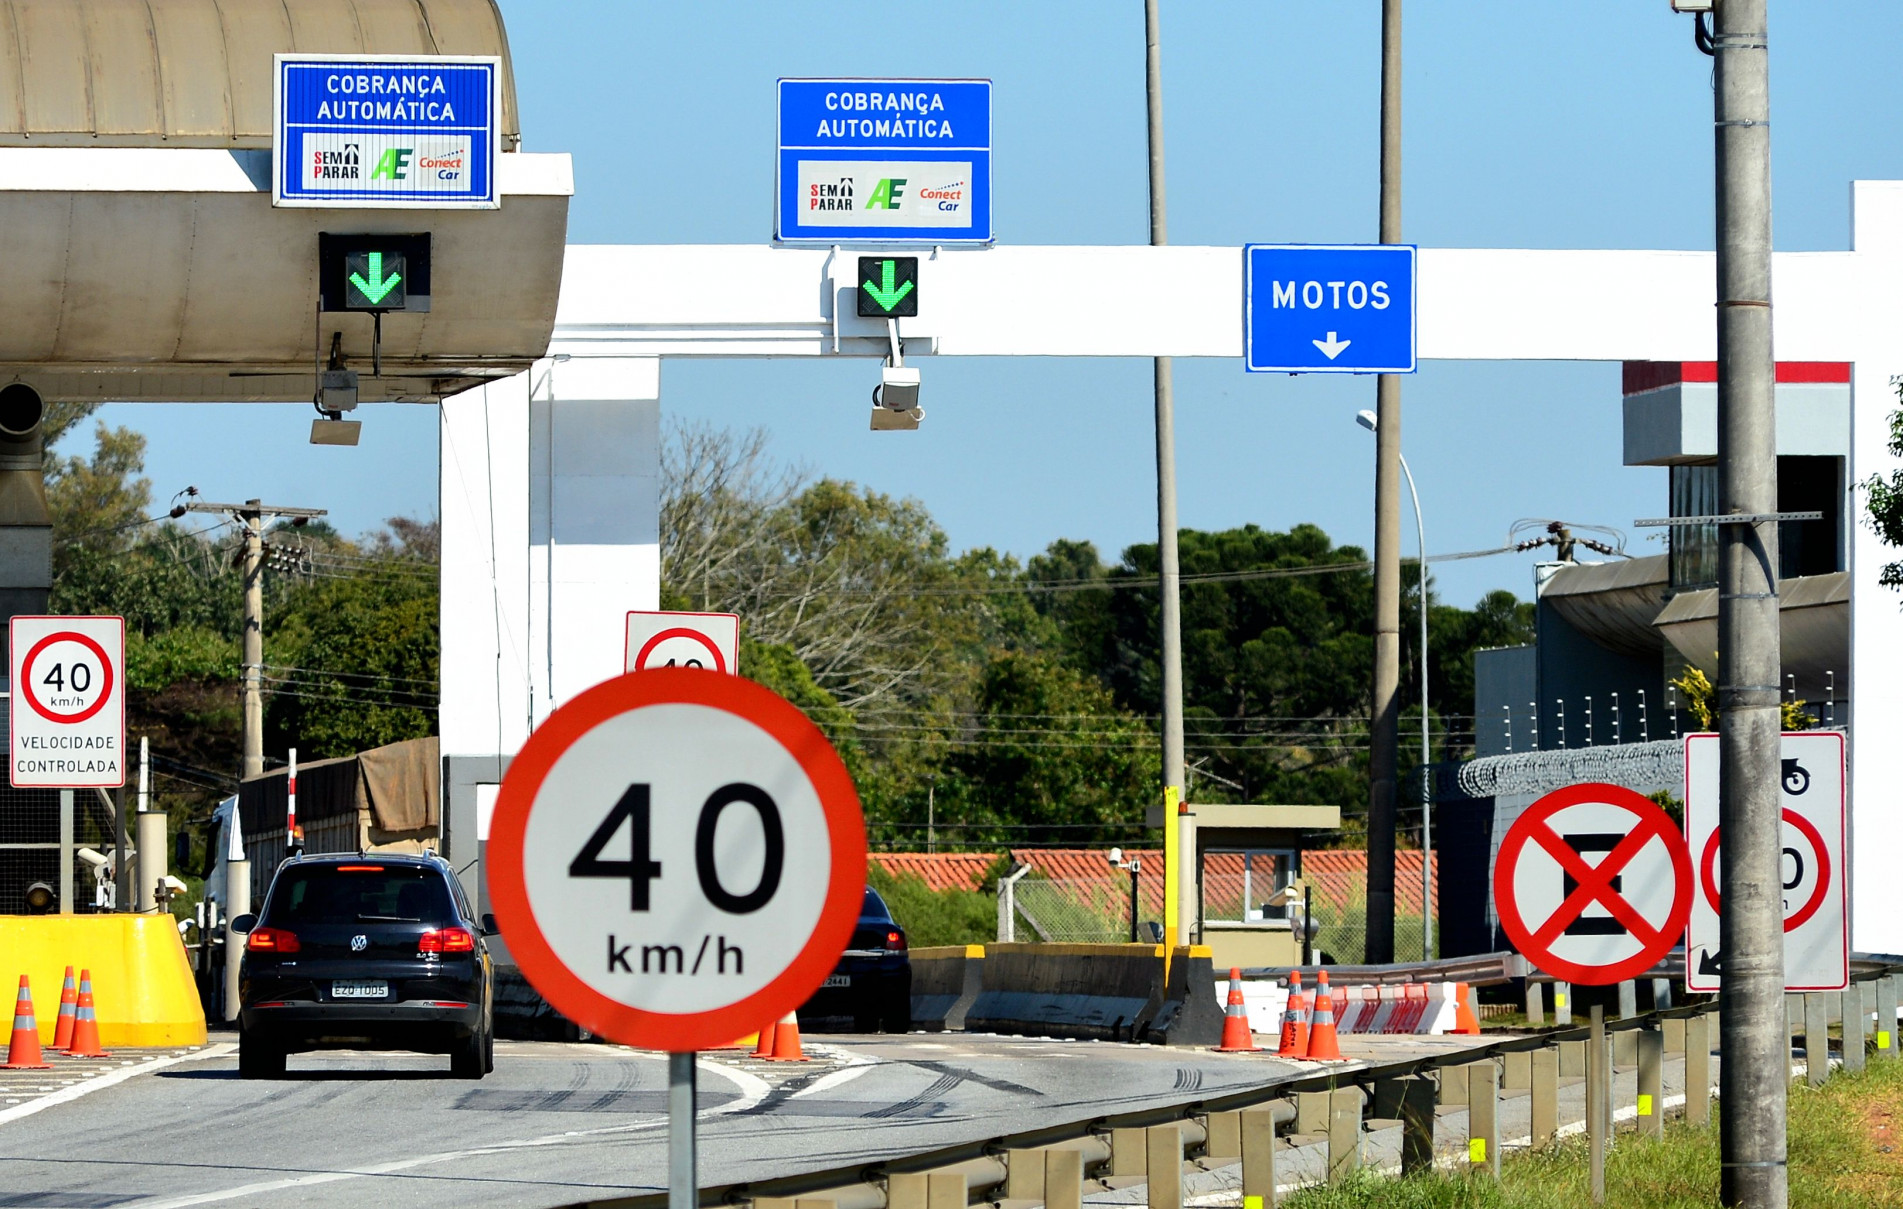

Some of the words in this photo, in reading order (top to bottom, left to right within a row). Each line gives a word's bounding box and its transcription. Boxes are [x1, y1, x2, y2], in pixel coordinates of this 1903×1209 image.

[326, 75, 446, 98] COBRANÇA
[316, 97, 456, 121] AUTOMÁTICA
[825, 92, 945, 115] COBRANÇA
[816, 112, 954, 138] AUTOMÁTICA
[314, 151, 342, 165] SEM
[371, 148, 414, 180] AE
[419, 157, 462, 169] Conect
[314, 165, 359, 180] PARAR
[437, 169, 460, 181] Car
[810, 184, 838, 197] SEM
[865, 178, 908, 210] AE
[920, 188, 962, 200] Conect
[810, 198, 853, 211] PARAR
[938, 200, 960, 212] Car
[1272, 280, 1391, 310] MOTOS
[43, 662, 91, 692] 40
[50, 696, 84, 707] km/h
[21, 736, 114, 749] VELOCIDADE
[17, 759, 117, 773] CONTROLADA
[568, 782, 785, 915] 40
[1783, 847, 1804, 890] 0
[607, 935, 745, 976] km/h
